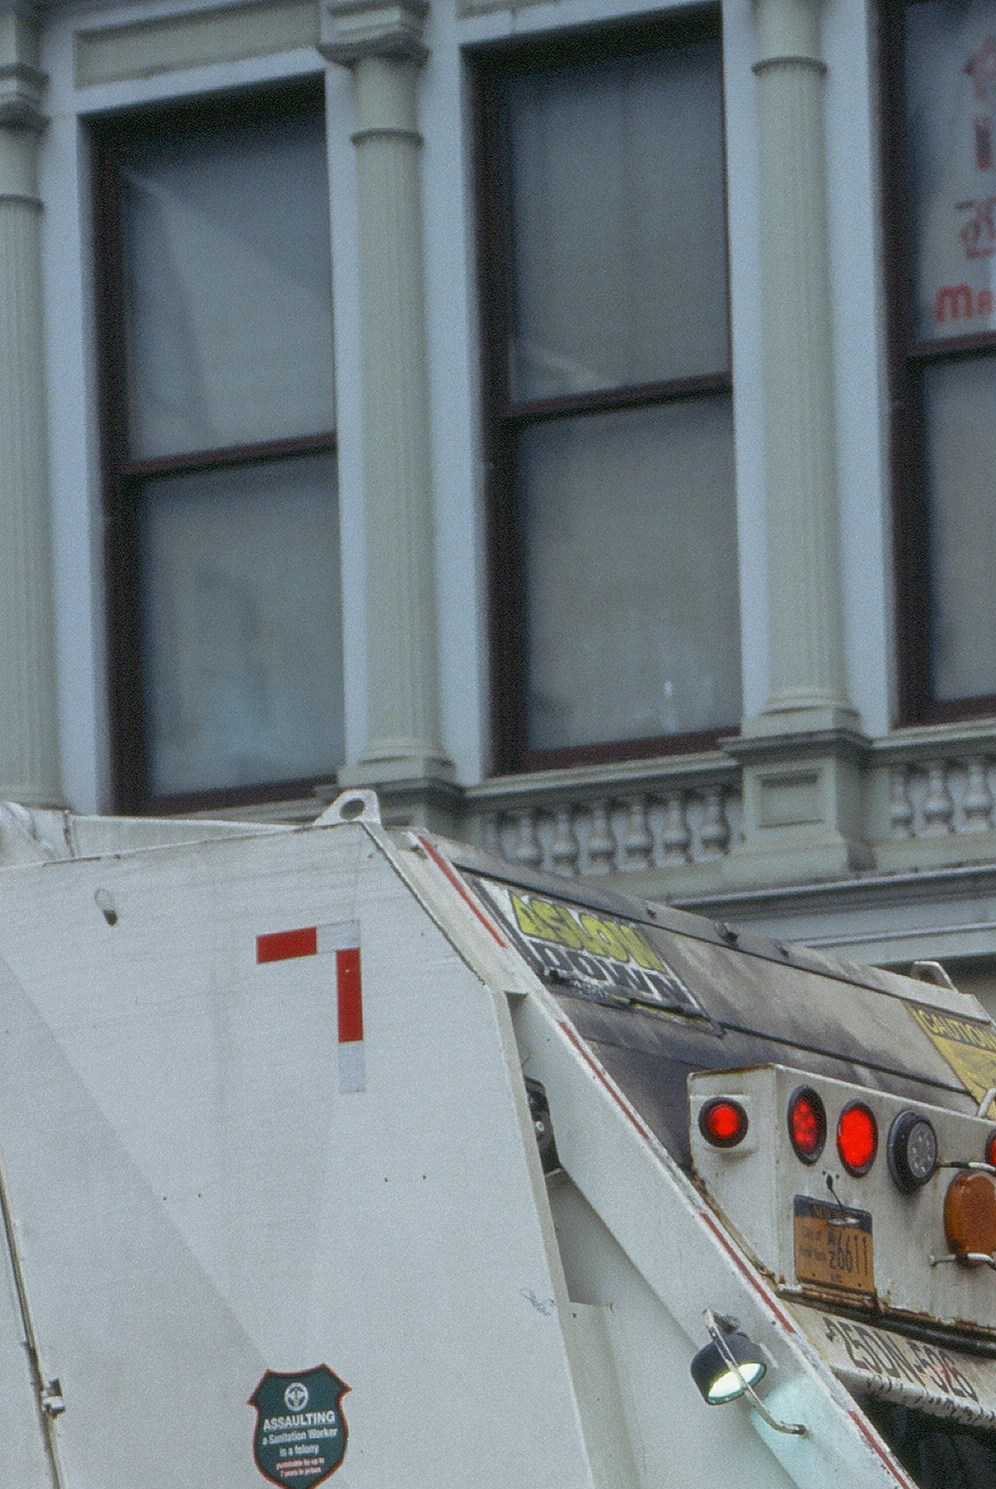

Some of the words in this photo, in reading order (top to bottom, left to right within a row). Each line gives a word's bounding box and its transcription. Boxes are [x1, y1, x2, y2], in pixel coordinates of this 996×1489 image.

[263, 1410, 336, 1432] ASSAULTING
[269, 1431, 307, 1445] Sanitation
[307, 1427, 338, 1439] Worker
